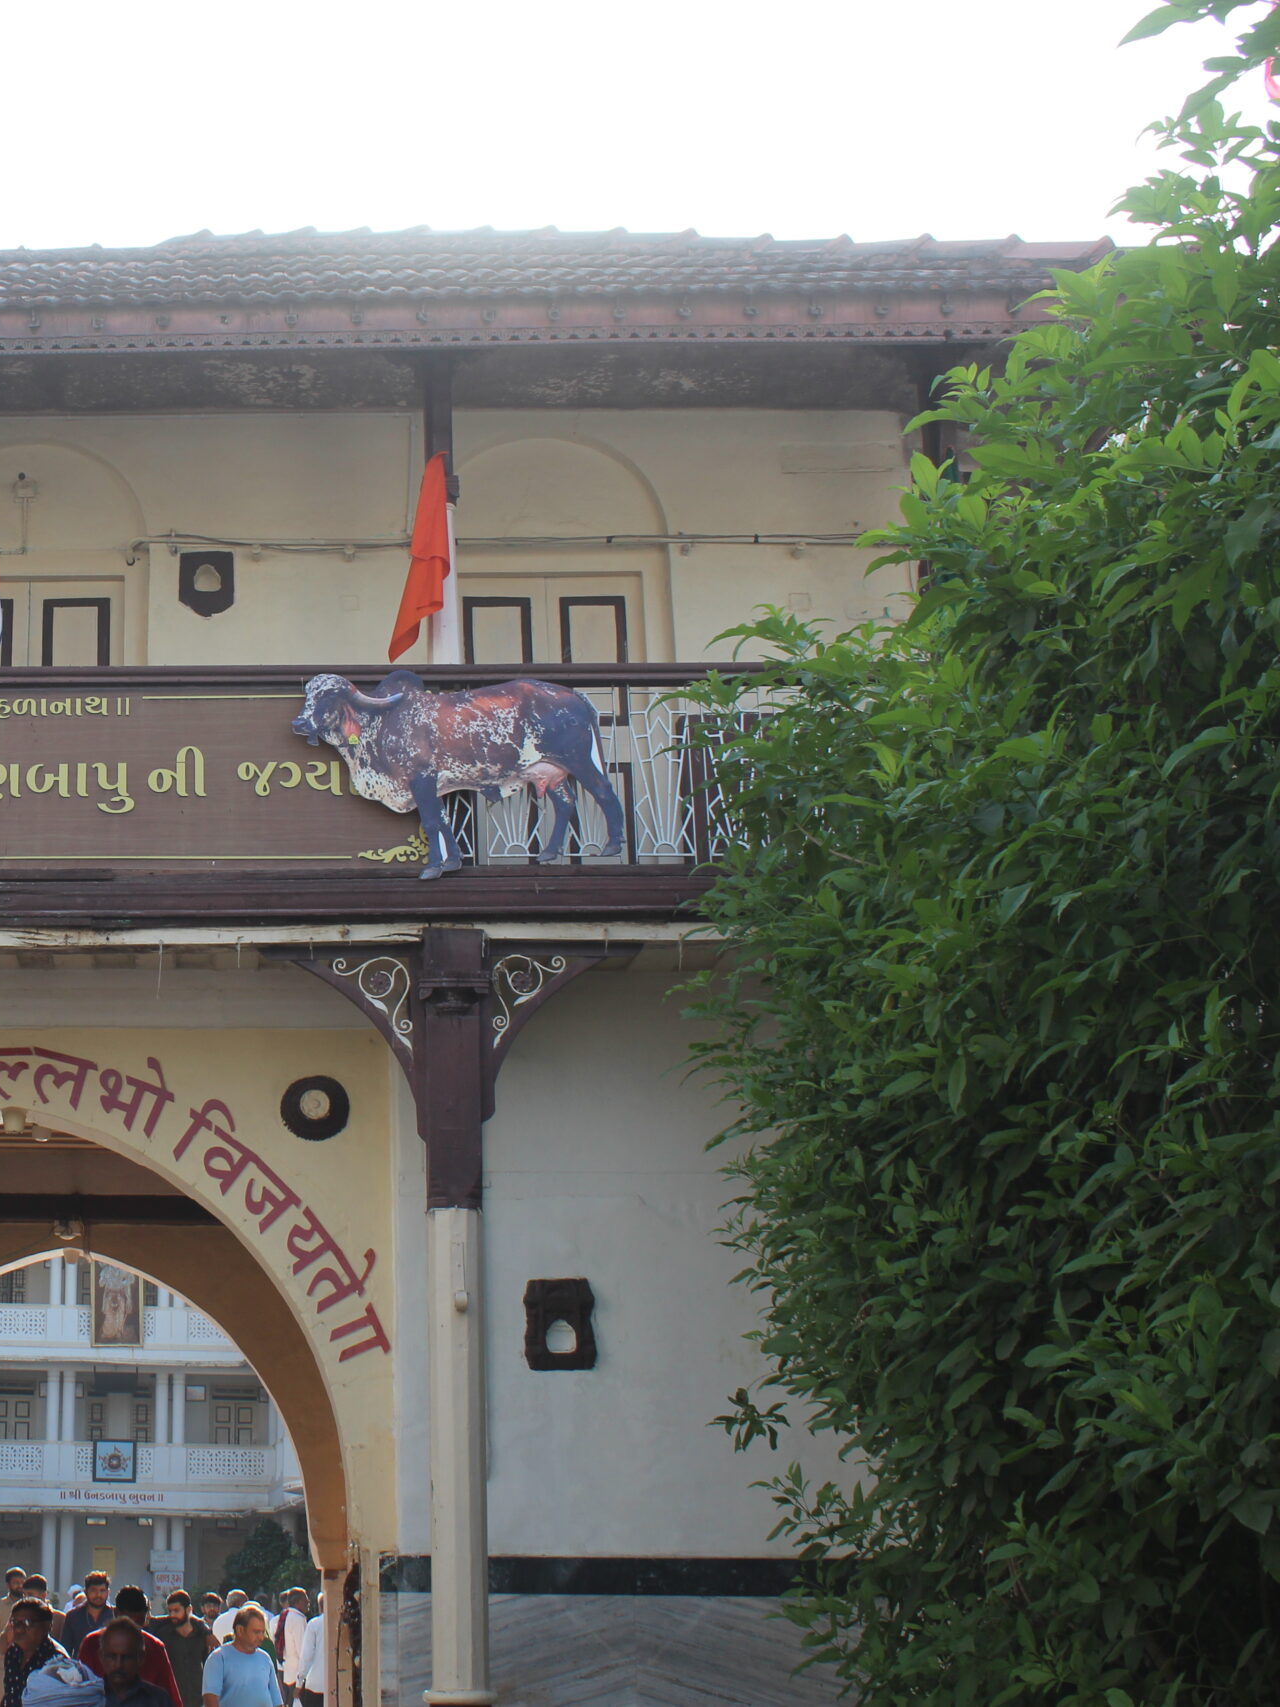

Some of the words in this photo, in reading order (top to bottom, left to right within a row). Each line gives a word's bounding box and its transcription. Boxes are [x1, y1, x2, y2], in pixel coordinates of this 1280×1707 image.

[147, 745, 208, 797] ની
[237, 760, 362, 797] જગ્ય
[173, 1099, 376, 1315] विजयते
